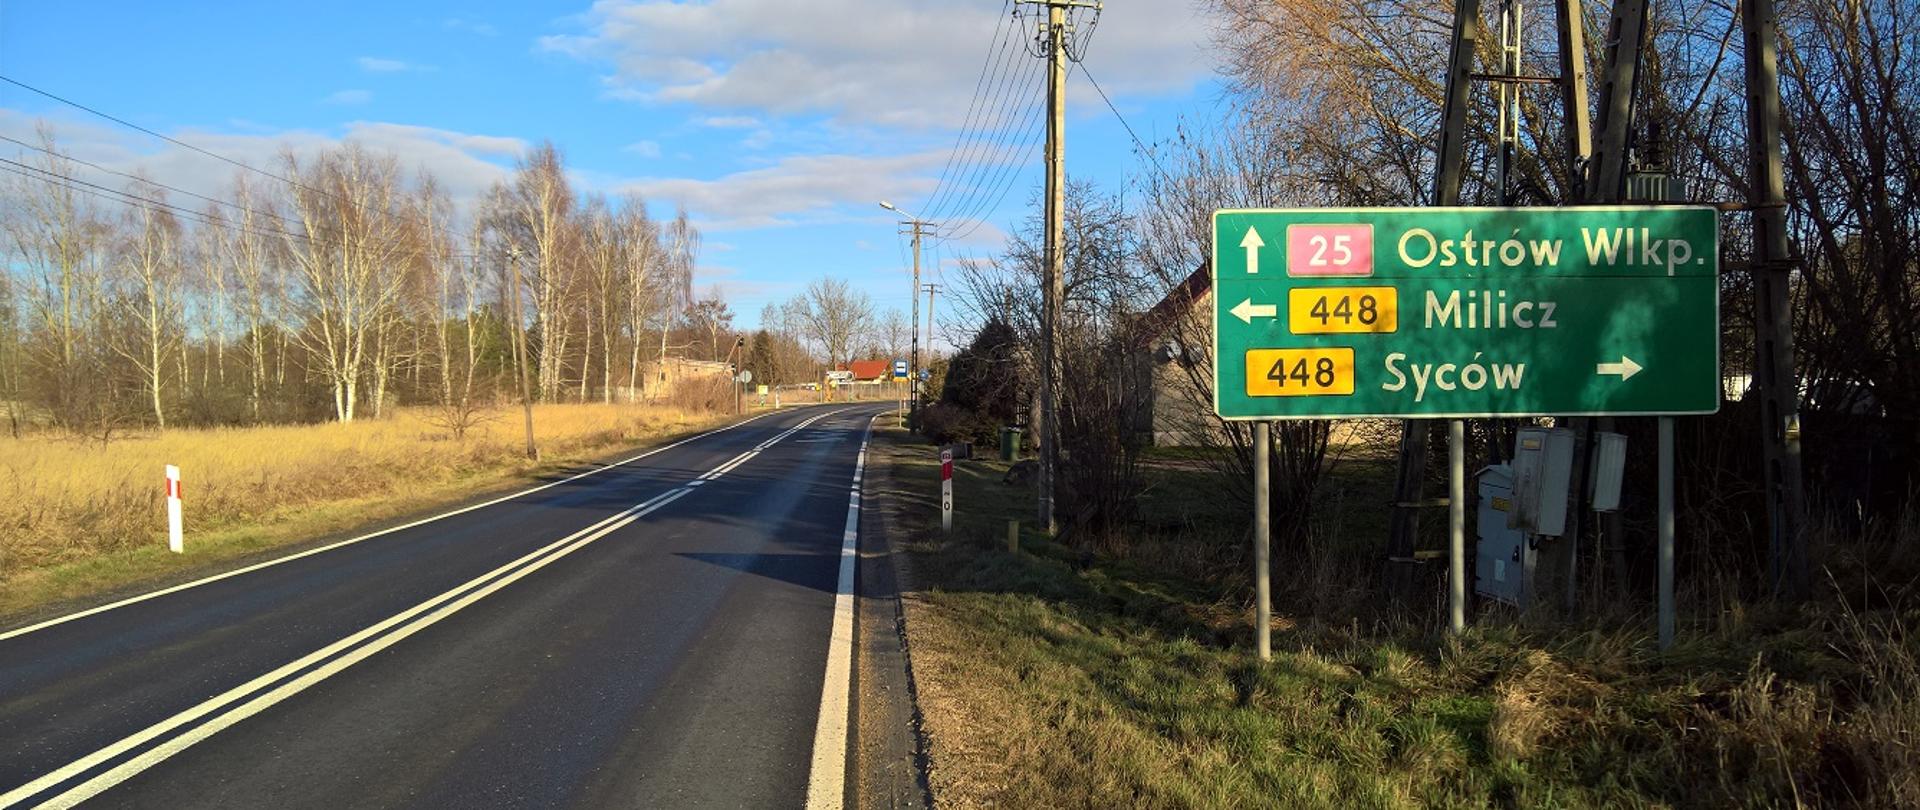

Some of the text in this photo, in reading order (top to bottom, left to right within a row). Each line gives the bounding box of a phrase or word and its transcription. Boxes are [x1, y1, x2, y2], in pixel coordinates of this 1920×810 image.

[1308, 227, 1704, 276] 25 Ostrów Wlkp.
[1310, 290, 1557, 328] 448 Milicz
[1266, 352, 1524, 402] 448 Syców
